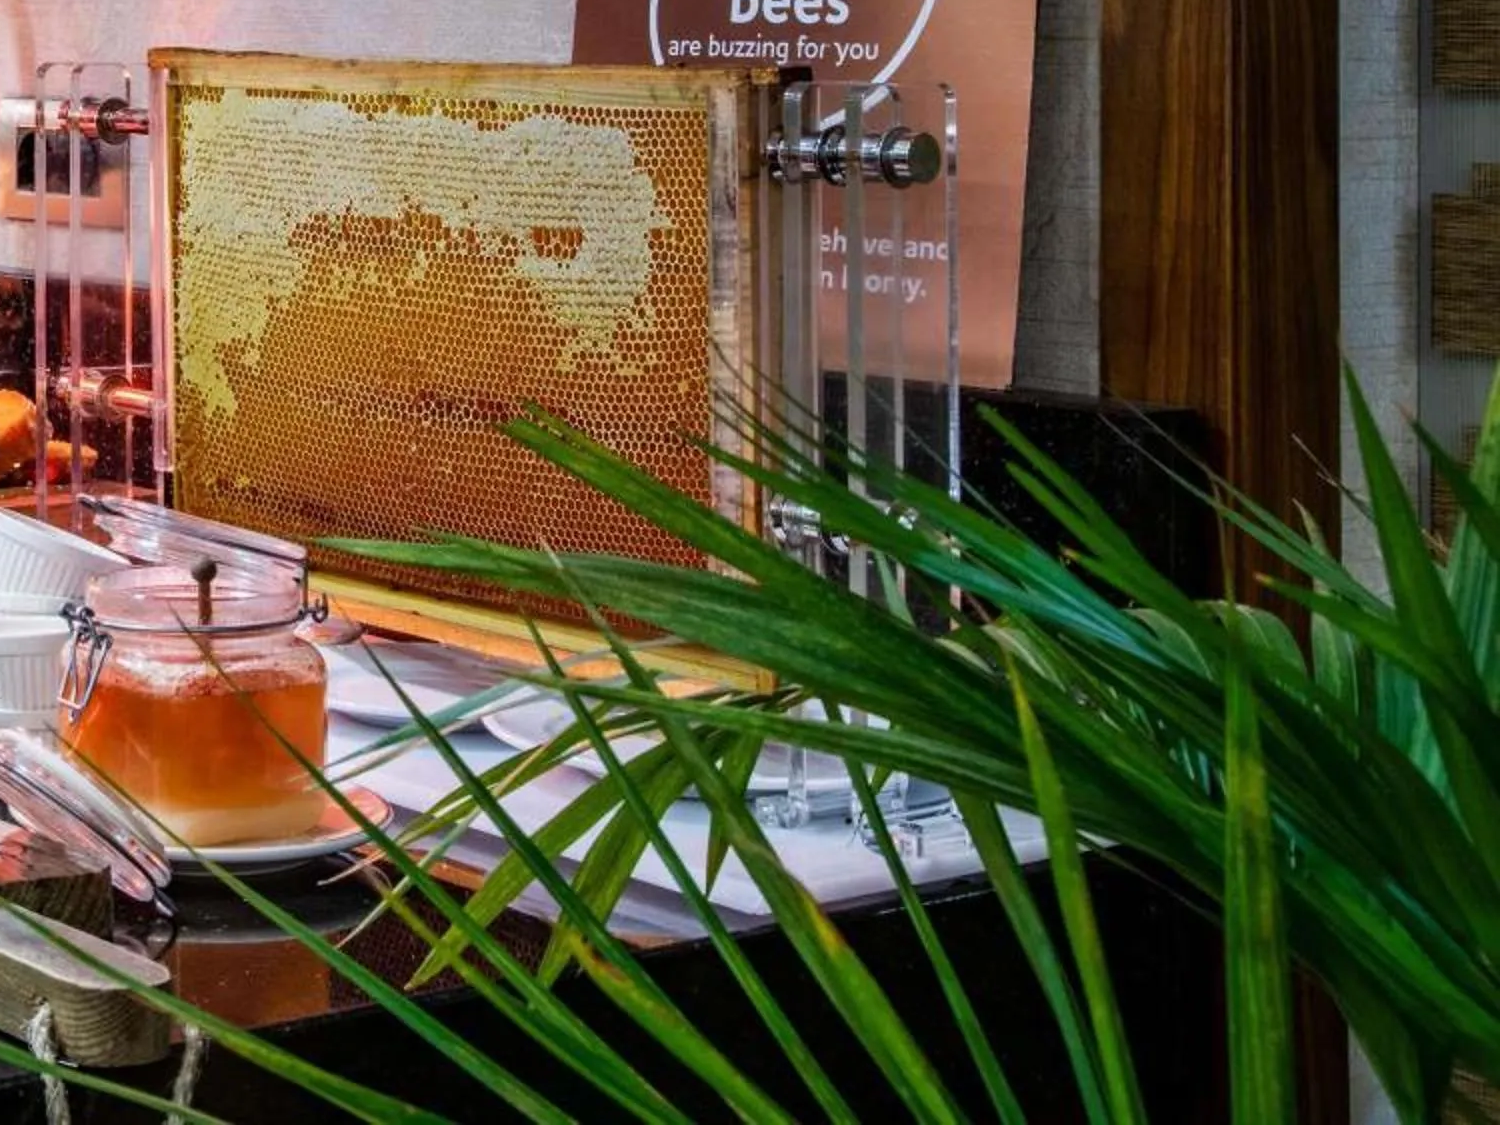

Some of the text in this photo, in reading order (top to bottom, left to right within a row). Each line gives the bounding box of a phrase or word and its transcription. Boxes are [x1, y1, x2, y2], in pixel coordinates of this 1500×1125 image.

[668, 32, 879, 65] are buzzing for you
